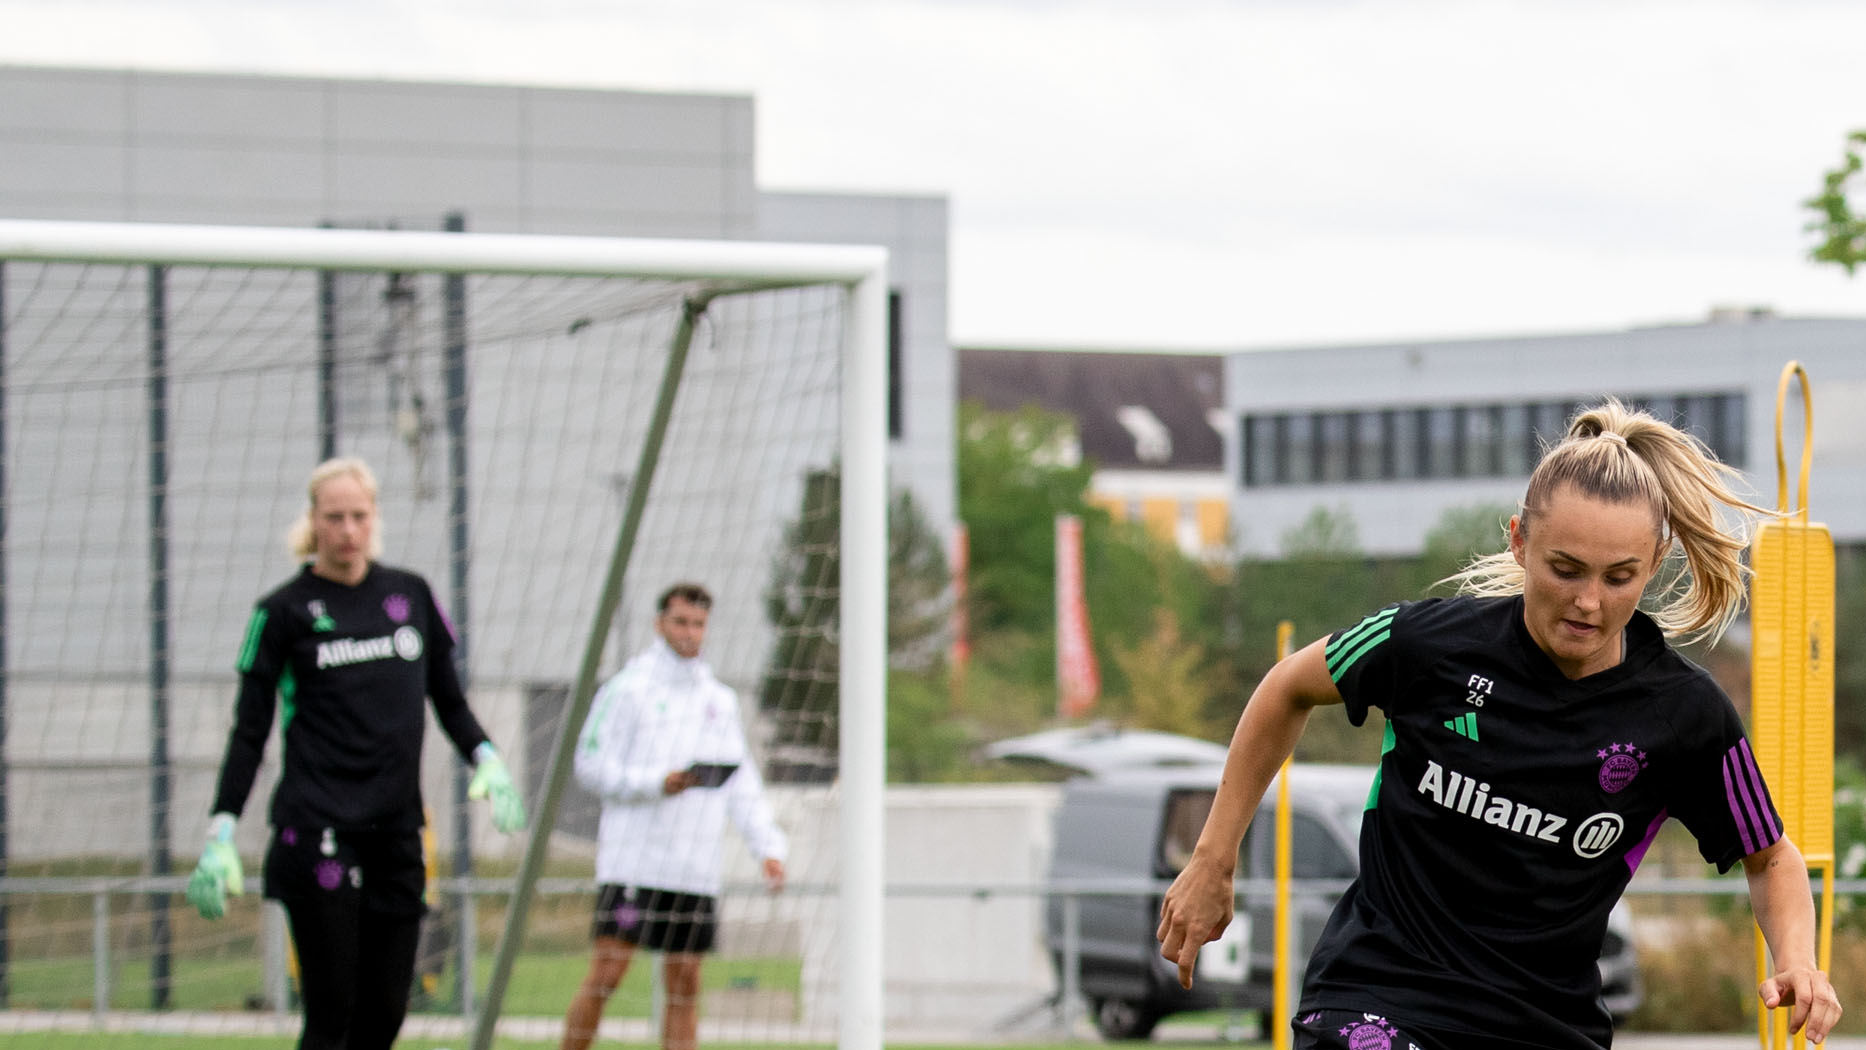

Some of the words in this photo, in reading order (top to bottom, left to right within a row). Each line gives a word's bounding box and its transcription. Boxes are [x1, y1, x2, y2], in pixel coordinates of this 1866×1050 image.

[317, 636, 395, 669] Allianz
[1467, 674, 1494, 695] FF1
[1417, 760, 1568, 843] Allianz
